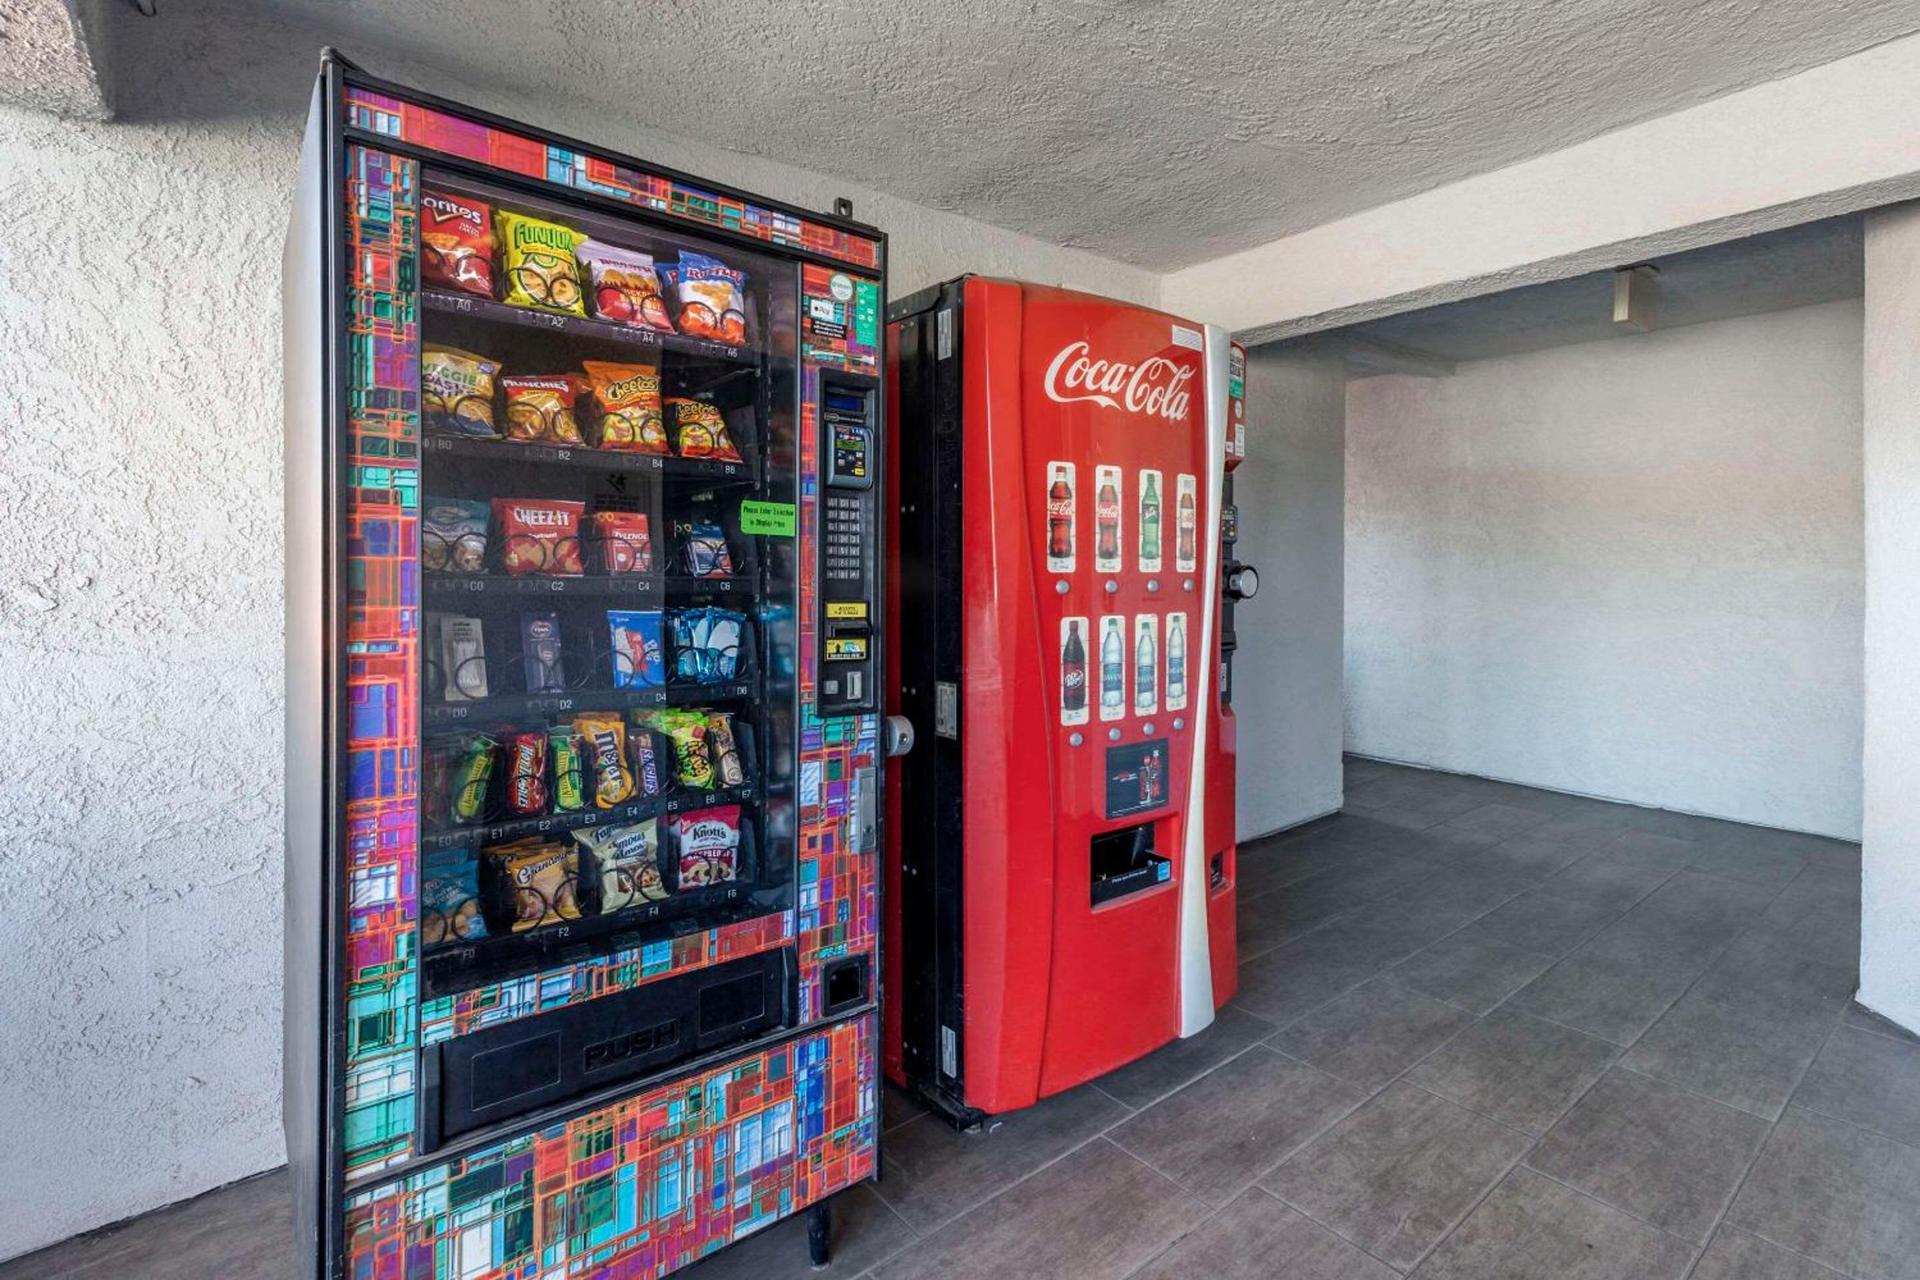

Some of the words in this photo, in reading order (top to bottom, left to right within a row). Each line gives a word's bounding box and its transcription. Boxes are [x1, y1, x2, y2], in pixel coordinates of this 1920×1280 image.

[421, 197, 482, 225] oritos
[515, 222, 575, 255] FUNYUN
[551, 317, 564, 328] A2
[503, 379, 569, 392] MUNCHIES
[606, 376, 659, 400] Cheetos
[558, 450, 571, 461] B2
[652, 458, 663, 468] B4
[551, 581, 564, 591] C2
[638, 581, 650, 591] C4
[655, 693, 666, 702] D4
[560, 699, 572, 710] D2
[741, 789, 751, 799] E7
[667, 800, 678, 811] E5
[627, 806, 638, 817] E4
[584, 813, 596, 824] E3
[540, 820, 551, 831] E2
[491, 828, 503, 840] E1
[692, 824, 727, 841] Knott's
[727, 889, 737, 899] F6
[558, 927, 570, 937] F2
